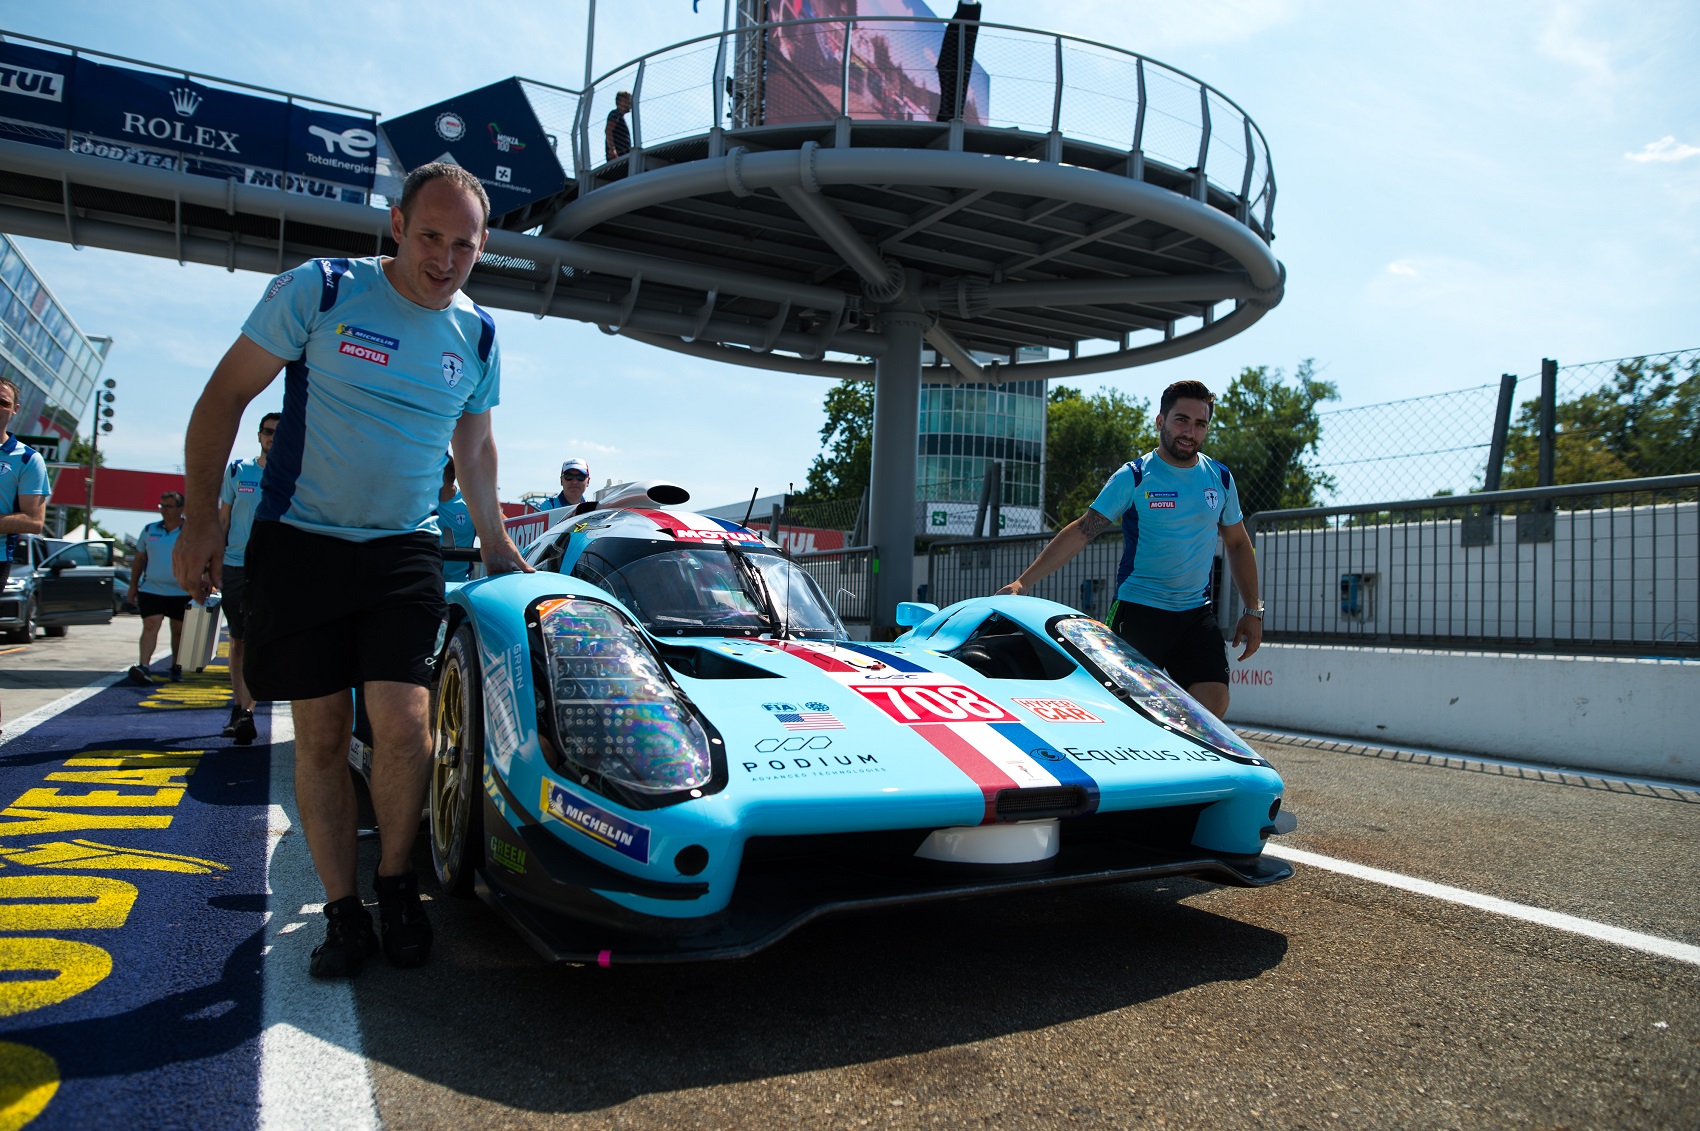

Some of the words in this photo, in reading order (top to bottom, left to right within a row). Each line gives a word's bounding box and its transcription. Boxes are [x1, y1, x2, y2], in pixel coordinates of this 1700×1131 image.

[0, 68, 57, 96] TUL
[122, 112, 240, 154] ROLEX
[306, 152, 375, 174] TotalEnergies
[250, 170, 337, 199] MOTUL
[354, 331, 395, 346] MICHELIN
[341, 344, 387, 364] MOTUL
[675, 529, 763, 543] MOTUL
[513, 643, 525, 690] GRAN
[1229, 668, 1274, 687] OKING
[763, 703, 795, 712] FIA
[856, 686, 1005, 720] 708
[1033, 707, 1097, 720] CAR
[742, 754, 879, 773] PODIUM
[1063, 746, 1222, 766] Equitus.us
[752, 772, 808, 782] ADVANCED
[812, 767, 888, 777] TECHNOLOGIES
[565, 804, 634, 847] MICHELIN
[490, 835, 527, 866] GREEN
